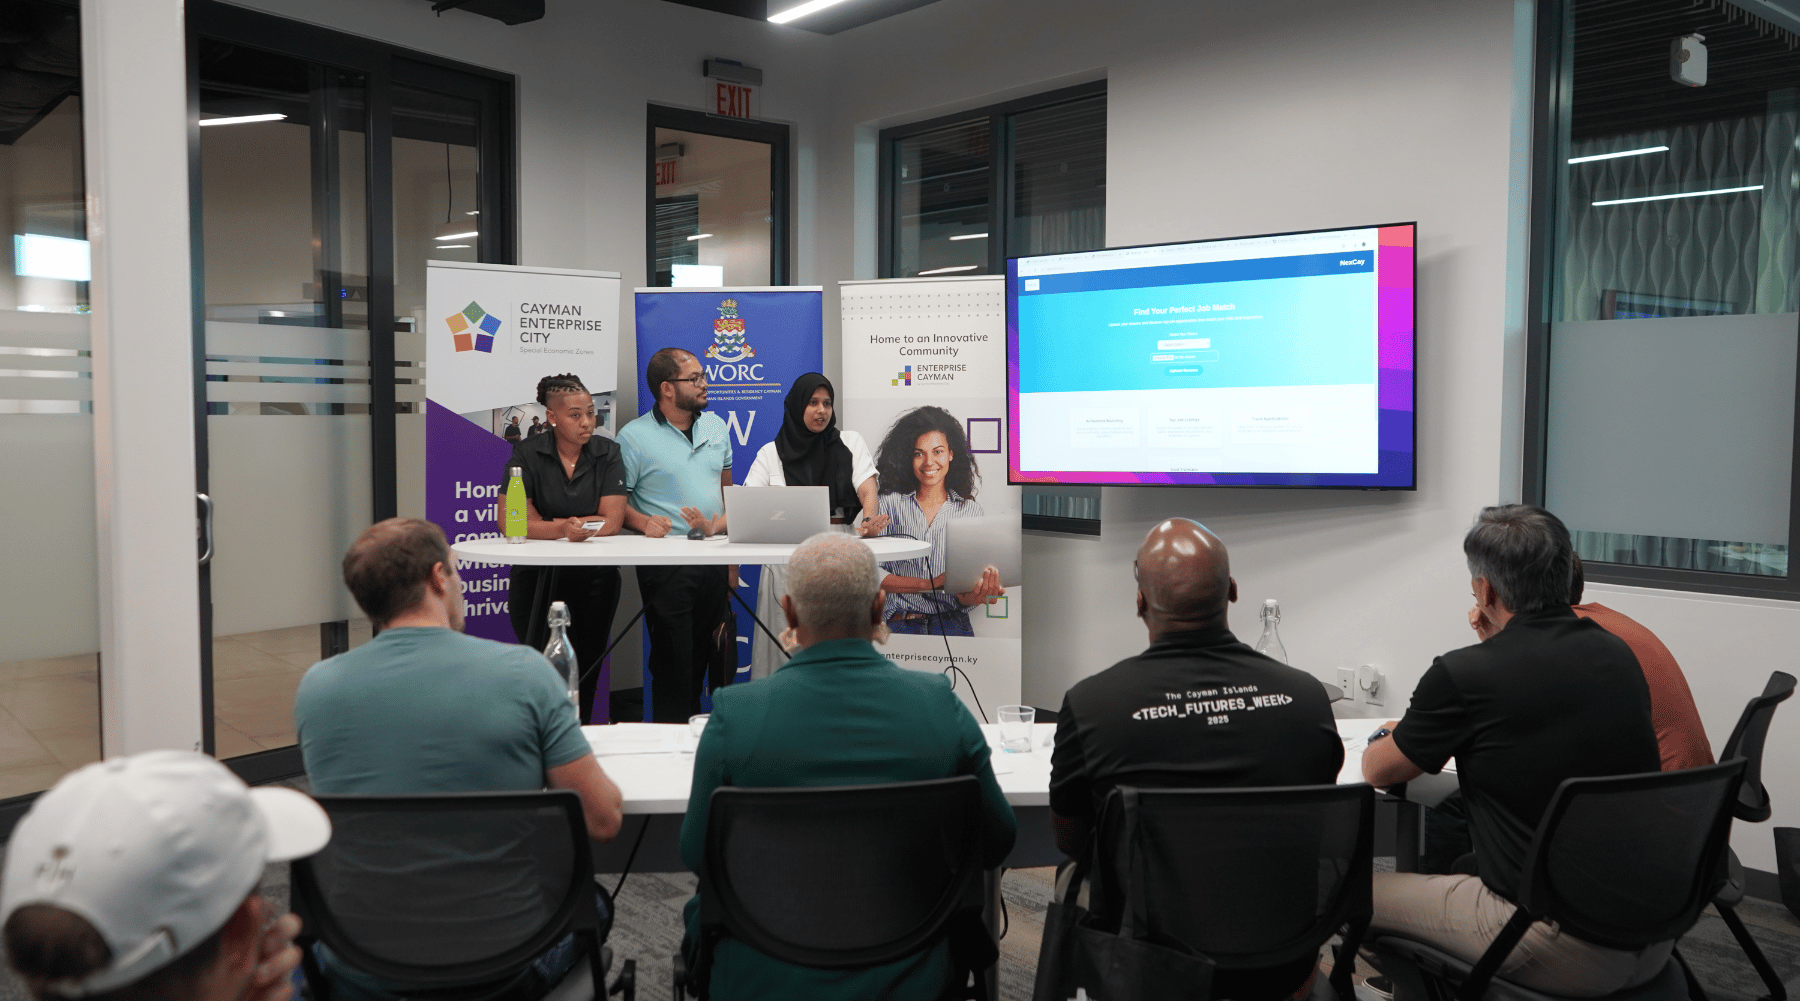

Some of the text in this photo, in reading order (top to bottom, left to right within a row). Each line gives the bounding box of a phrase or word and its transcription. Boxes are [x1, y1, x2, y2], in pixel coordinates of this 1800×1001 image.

[716, 83, 752, 118] EXIT
[655, 161, 676, 186] EXIT
[520, 303, 581, 316] CAYMAN
[1134, 303, 1235, 316] Find Your Perfect Job Match
[520, 317, 602, 331] ENTERPRISE
[520, 332, 551, 343] CITY
[870, 335, 900, 343] Home
[904, 335, 914, 343] to
[933, 333, 988, 342] Innovative
[899, 346, 959, 357] Community
[705, 364, 764, 381] WORC
[455, 503, 498, 522] a vil
[1187, 689, 1218, 699] Cayman
[1223, 685, 1258, 695] Islands
[1132, 694, 1293, 720] <TECH_FUTURES_WEEK>
[1207, 715, 1229, 725] 2025
